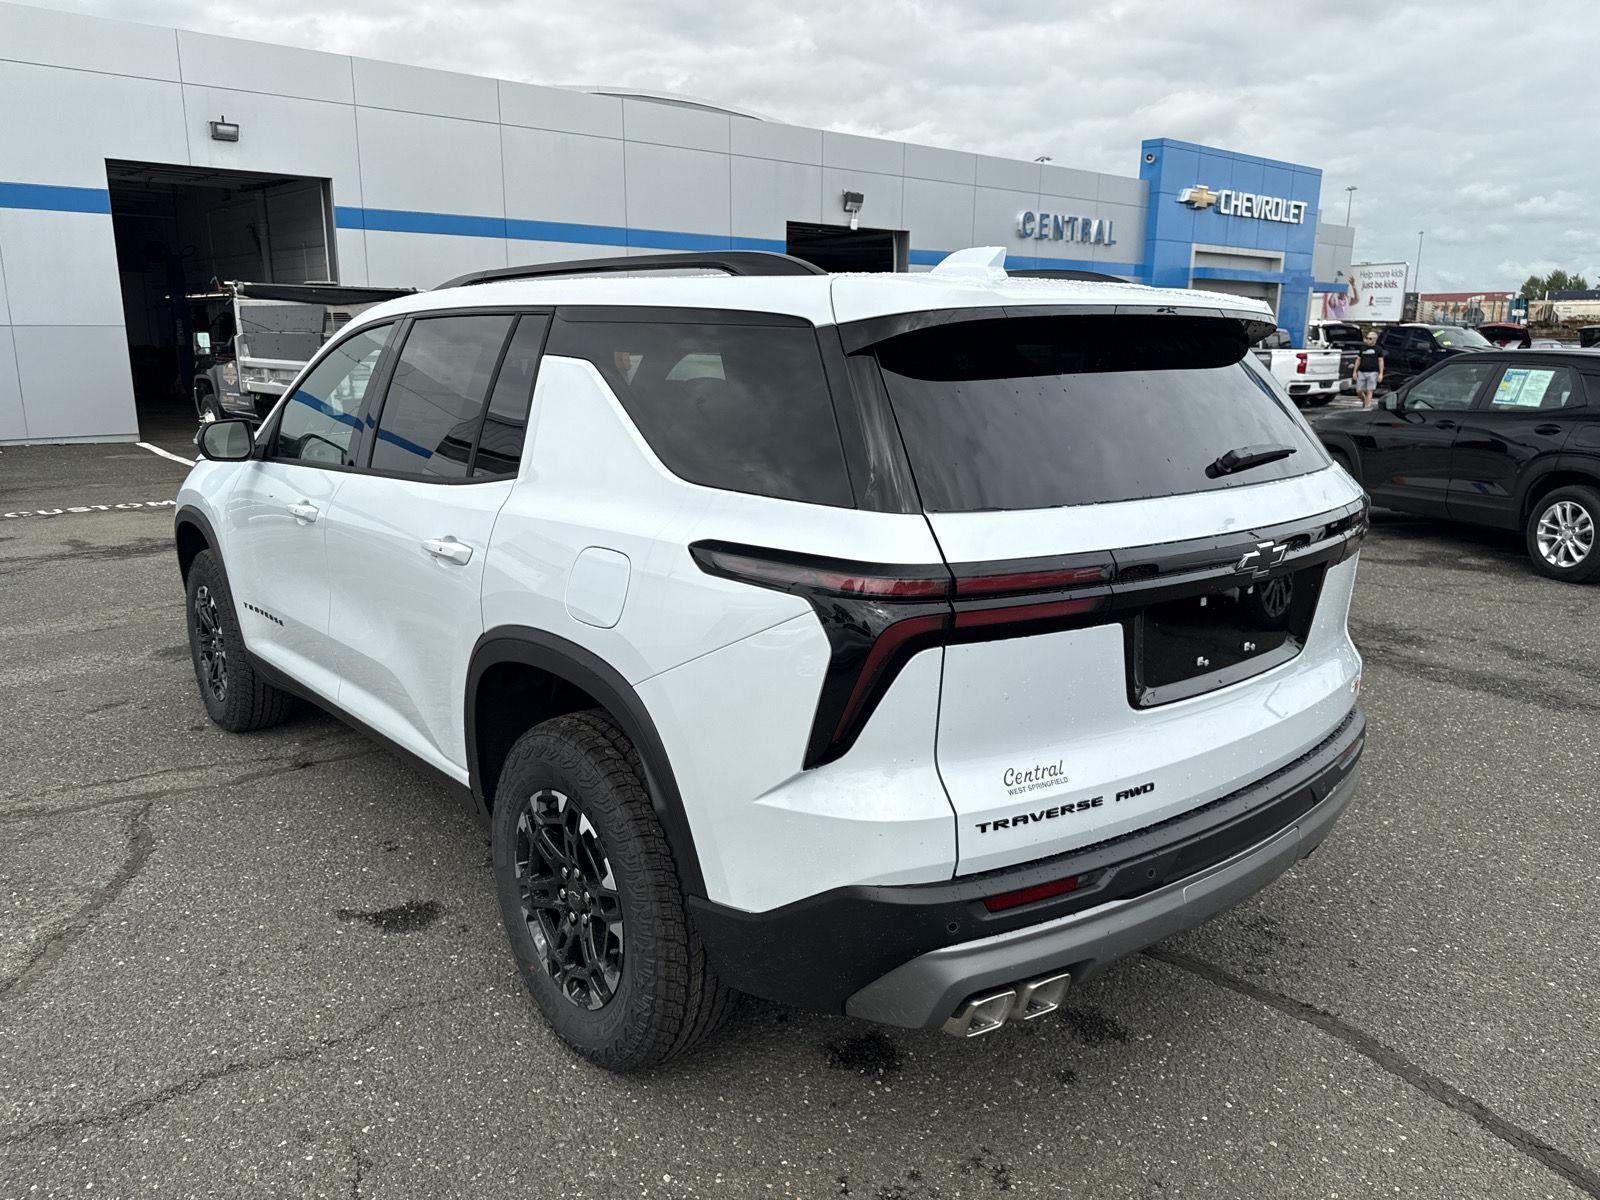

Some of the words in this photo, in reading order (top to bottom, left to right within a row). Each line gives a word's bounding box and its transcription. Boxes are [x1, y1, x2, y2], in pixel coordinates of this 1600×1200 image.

[1219, 189, 1308, 225] CHEVROLET
[1017, 210, 1117, 246] CENTRAL
[1360, 270, 1374, 280] Help
[1374, 271, 1390, 279] more
[1391, 268, 1404, 278] kids
[1361, 280, 1374, 291] just
[1374, 280, 1383, 289] be
[1383, 280, 1399, 289] kids.
[243, 601, 285, 628] TRAVERSE
[1003, 759, 1064, 787] Central
[1007, 786, 1027, 796] WEST
[1027, 776, 1069, 792] SPRINGFIELD
[975, 795, 1104, 834] TRAVERSE
[1115, 782, 1155, 802] AWD
